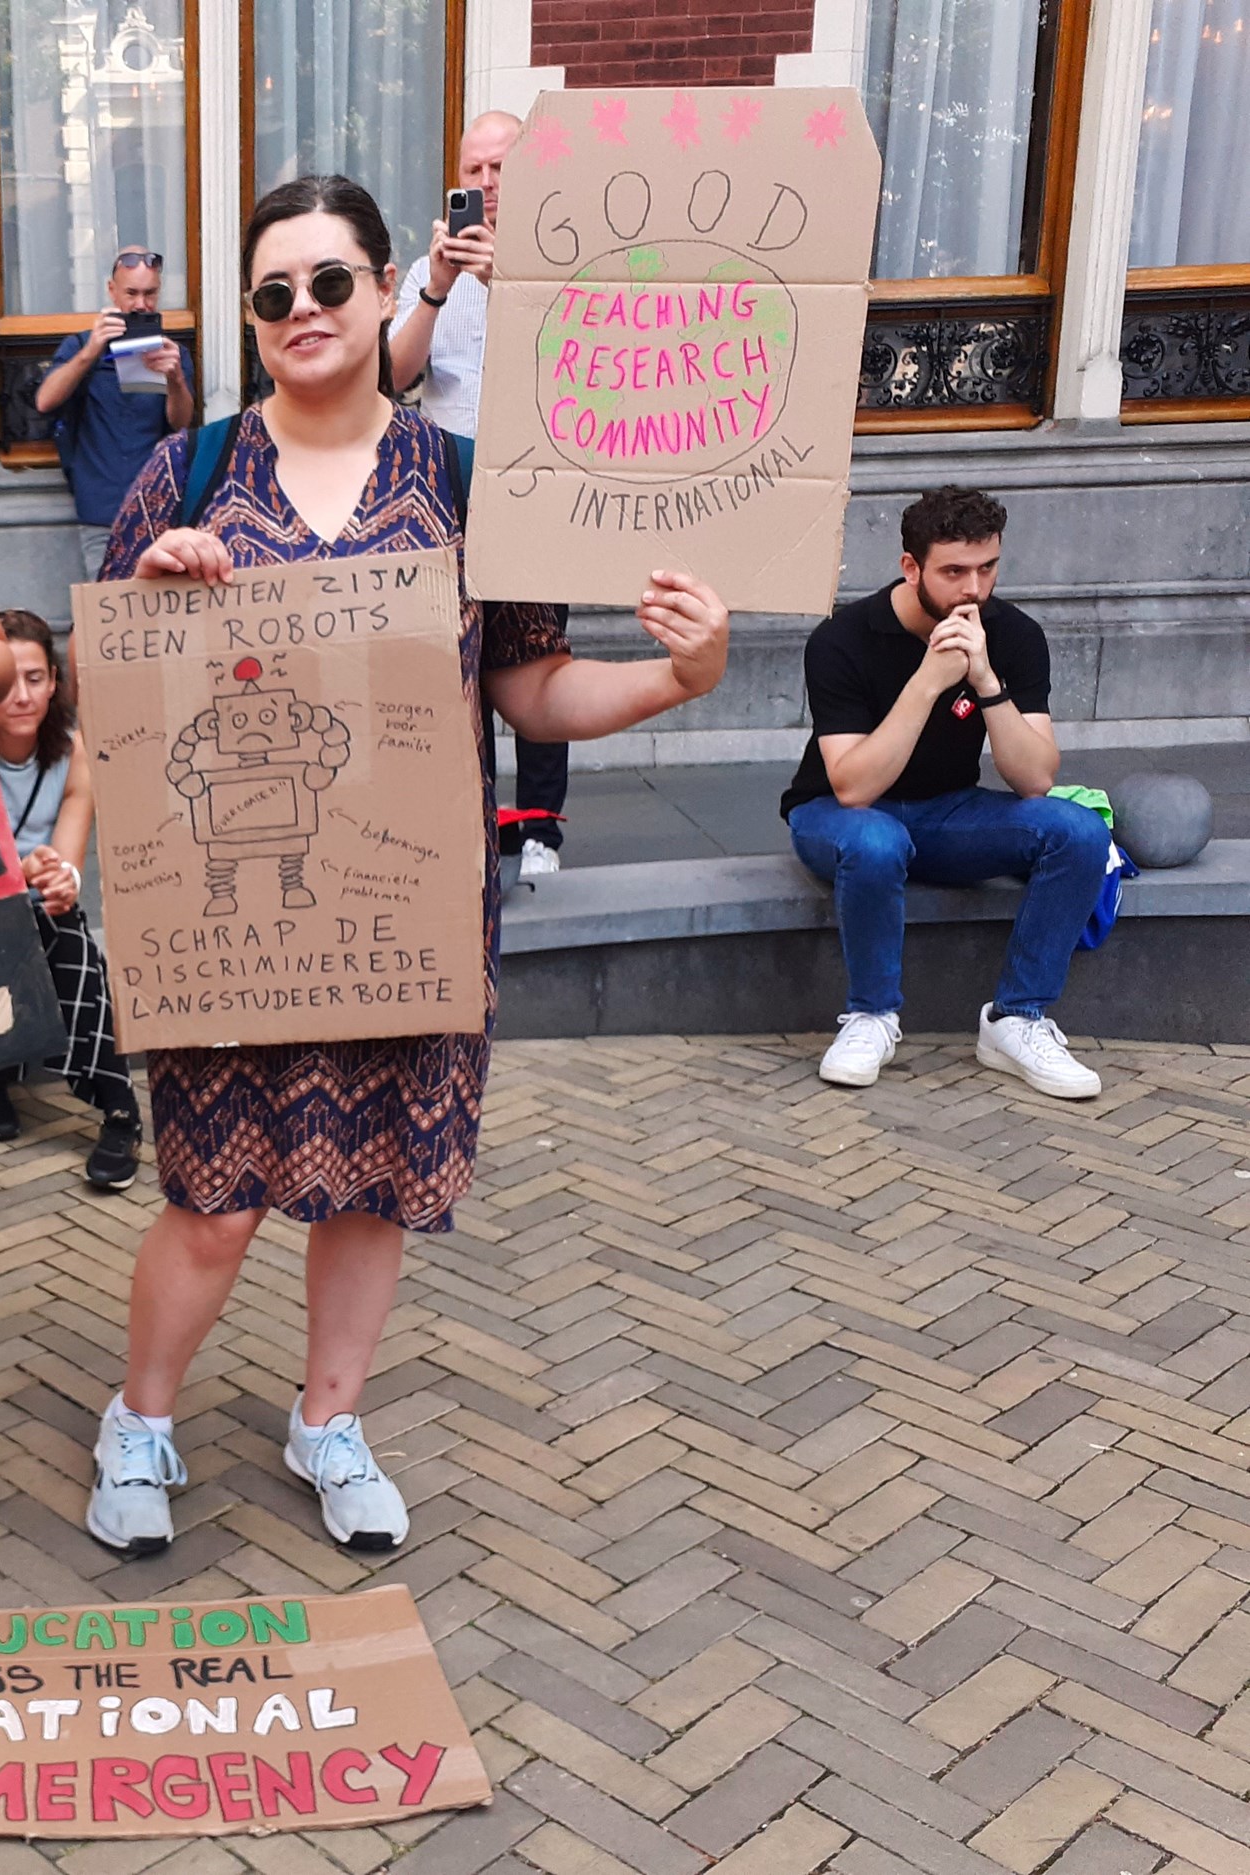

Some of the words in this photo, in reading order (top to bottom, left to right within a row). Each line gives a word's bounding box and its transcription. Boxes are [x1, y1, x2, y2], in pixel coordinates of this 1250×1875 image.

[534, 169, 808, 266] GOOD
[559, 279, 758, 330] TEACHING
[553, 334, 770, 390] RESEARCH
[550, 383, 774, 459] COMMUNITY
[497, 446, 556, 499] IS
[569, 436, 815, 532] INTERNATIONAL
[99, 578, 286, 624] STUDENTEN
[313, 566, 419, 595] ZIJN
[100, 629, 188, 662] GEEN
[223, 602, 390, 650] ROBOTS
[375, 701, 434, 721] zorgen
[112, 840, 165, 857] zorgen
[121, 857, 157, 872] over
[141, 920, 296, 957] SCHRAP
[336, 914, 397, 945] DE
[123, 948, 438, 987] DISCRIMINEREDE
[65, 1662, 142, 1690] THE
[170, 1654, 294, 1690] REAL
